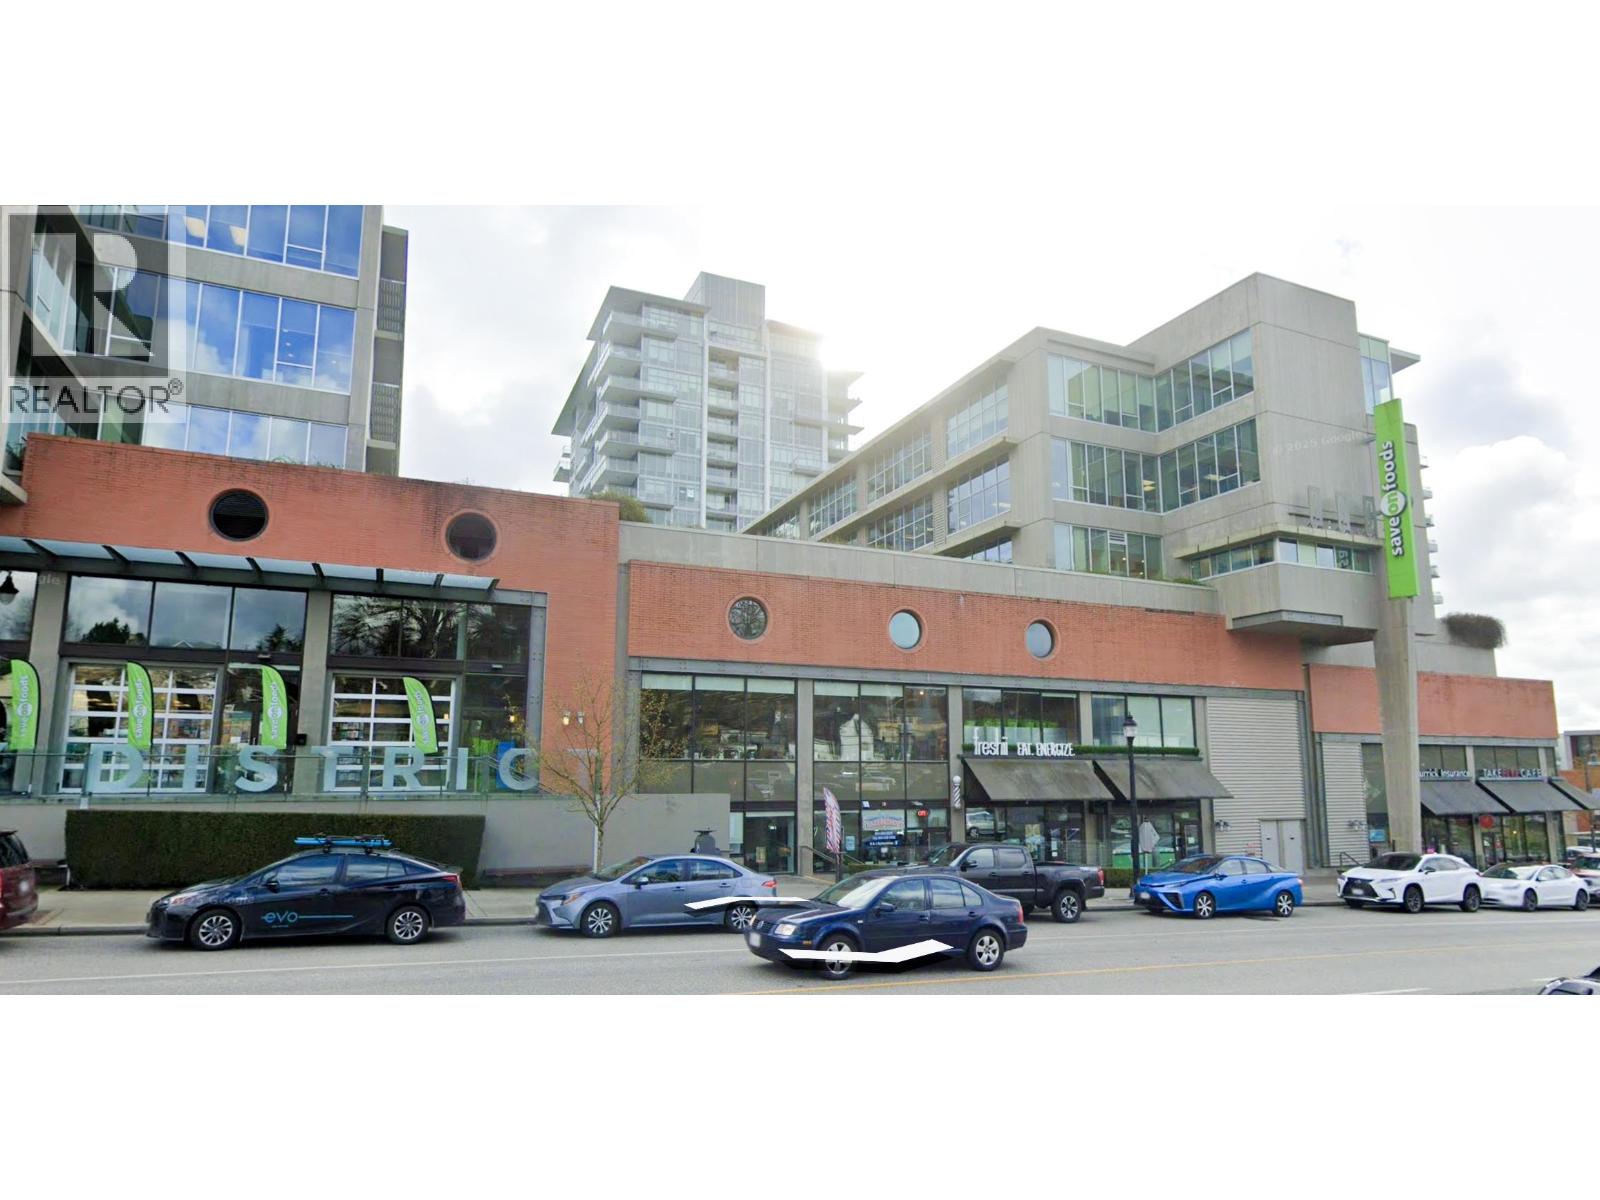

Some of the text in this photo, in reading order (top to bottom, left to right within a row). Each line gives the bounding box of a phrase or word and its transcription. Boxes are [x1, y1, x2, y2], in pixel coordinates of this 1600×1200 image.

[1379, 440, 1404, 557] save on foods
[265, 910, 298, 923] evo
